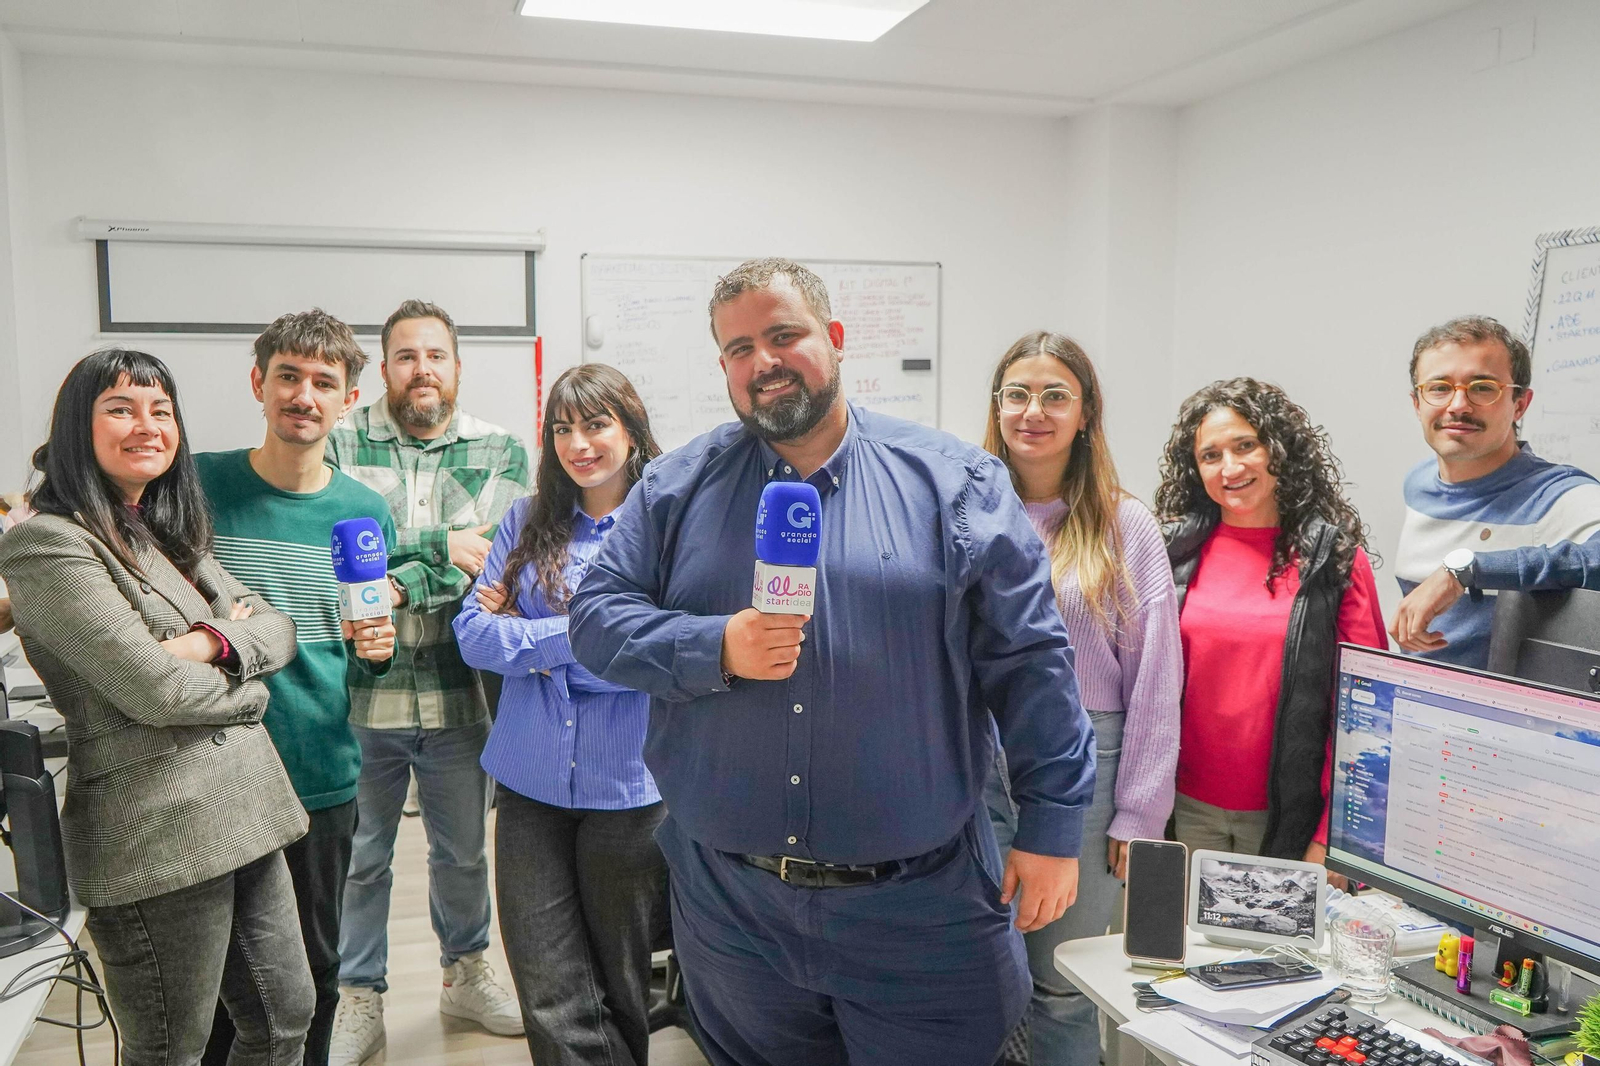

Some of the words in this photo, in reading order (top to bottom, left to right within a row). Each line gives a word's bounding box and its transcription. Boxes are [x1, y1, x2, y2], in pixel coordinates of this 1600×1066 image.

[766, 597, 812, 607] startidea
[1203, 911, 1221, 922] 11:12
[1488, 924, 1516, 939] ASUS
